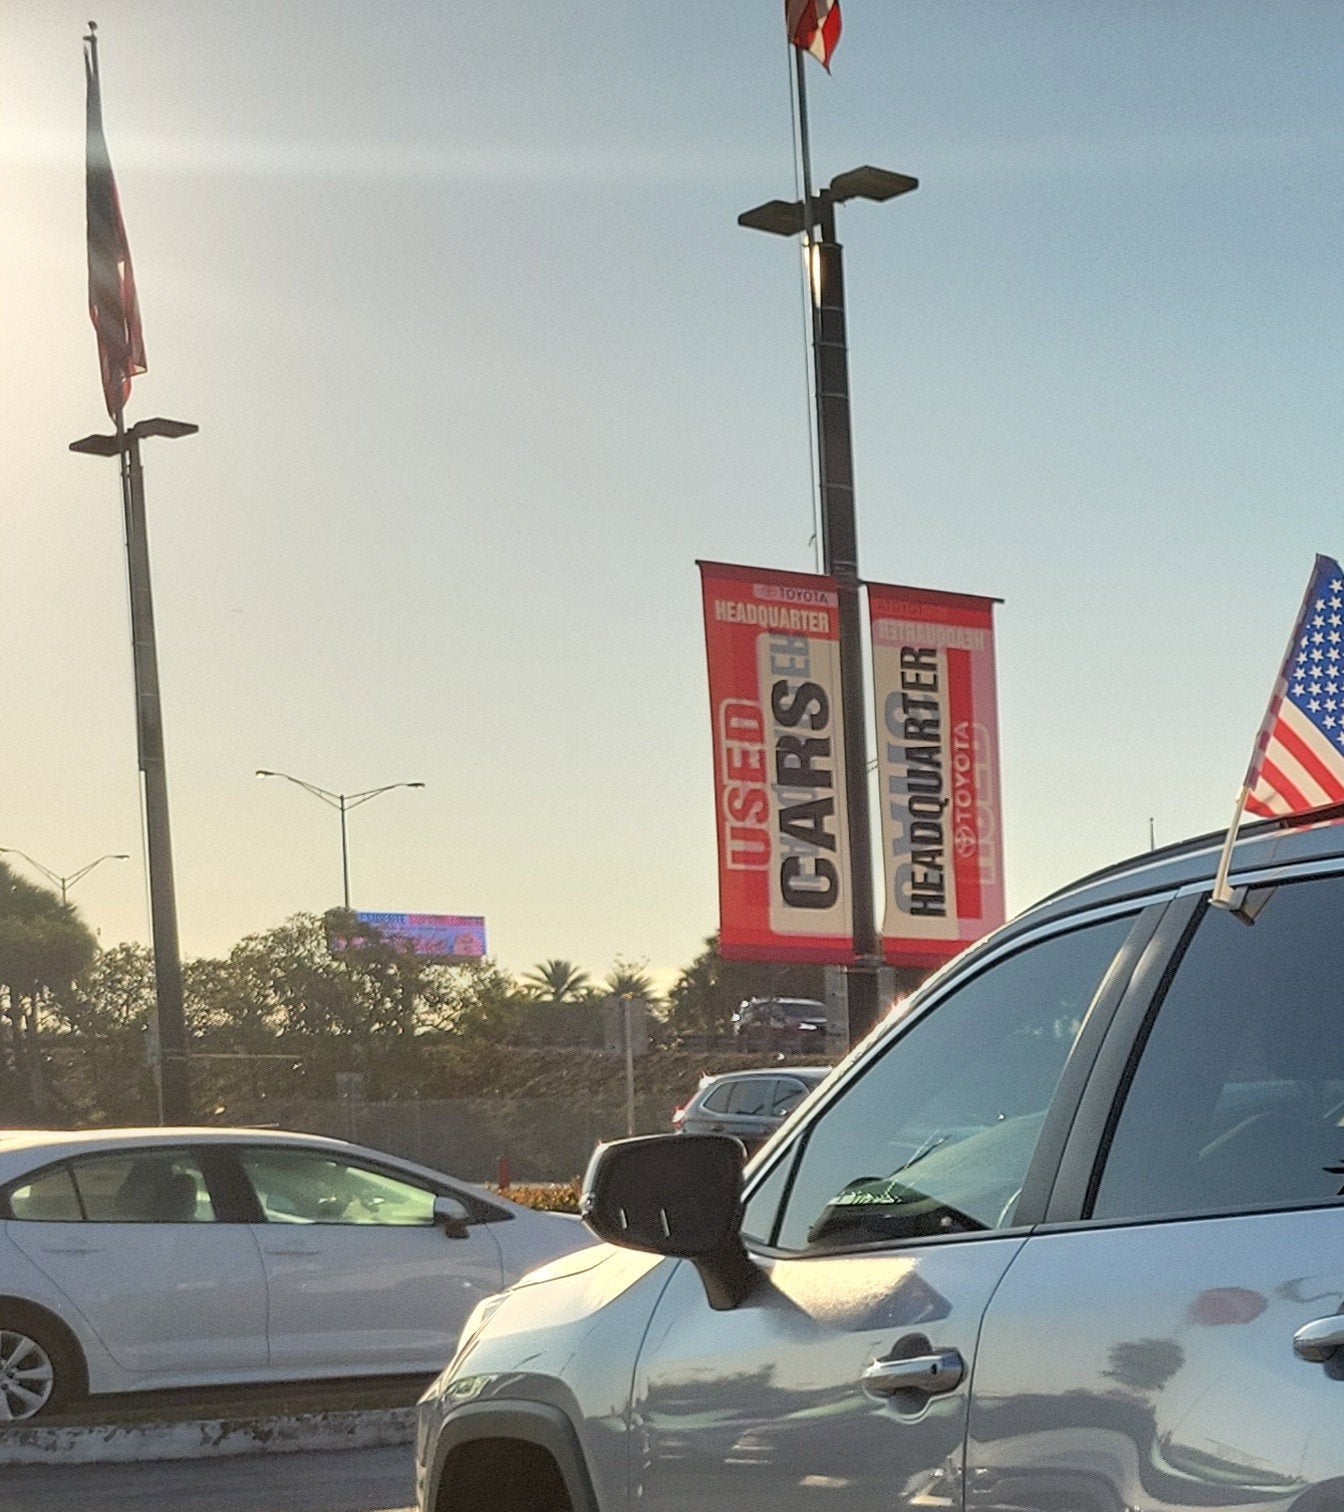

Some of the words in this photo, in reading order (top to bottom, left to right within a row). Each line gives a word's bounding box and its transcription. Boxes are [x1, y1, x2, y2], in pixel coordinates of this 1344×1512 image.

[714, 599, 830, 634] HEADQUARTER
[721, 699, 772, 870] USED
[771, 679, 839, 910] CARS
[899, 646, 948, 917] HEADQUARTER
[953, 720, 973, 824] TOYOTA
